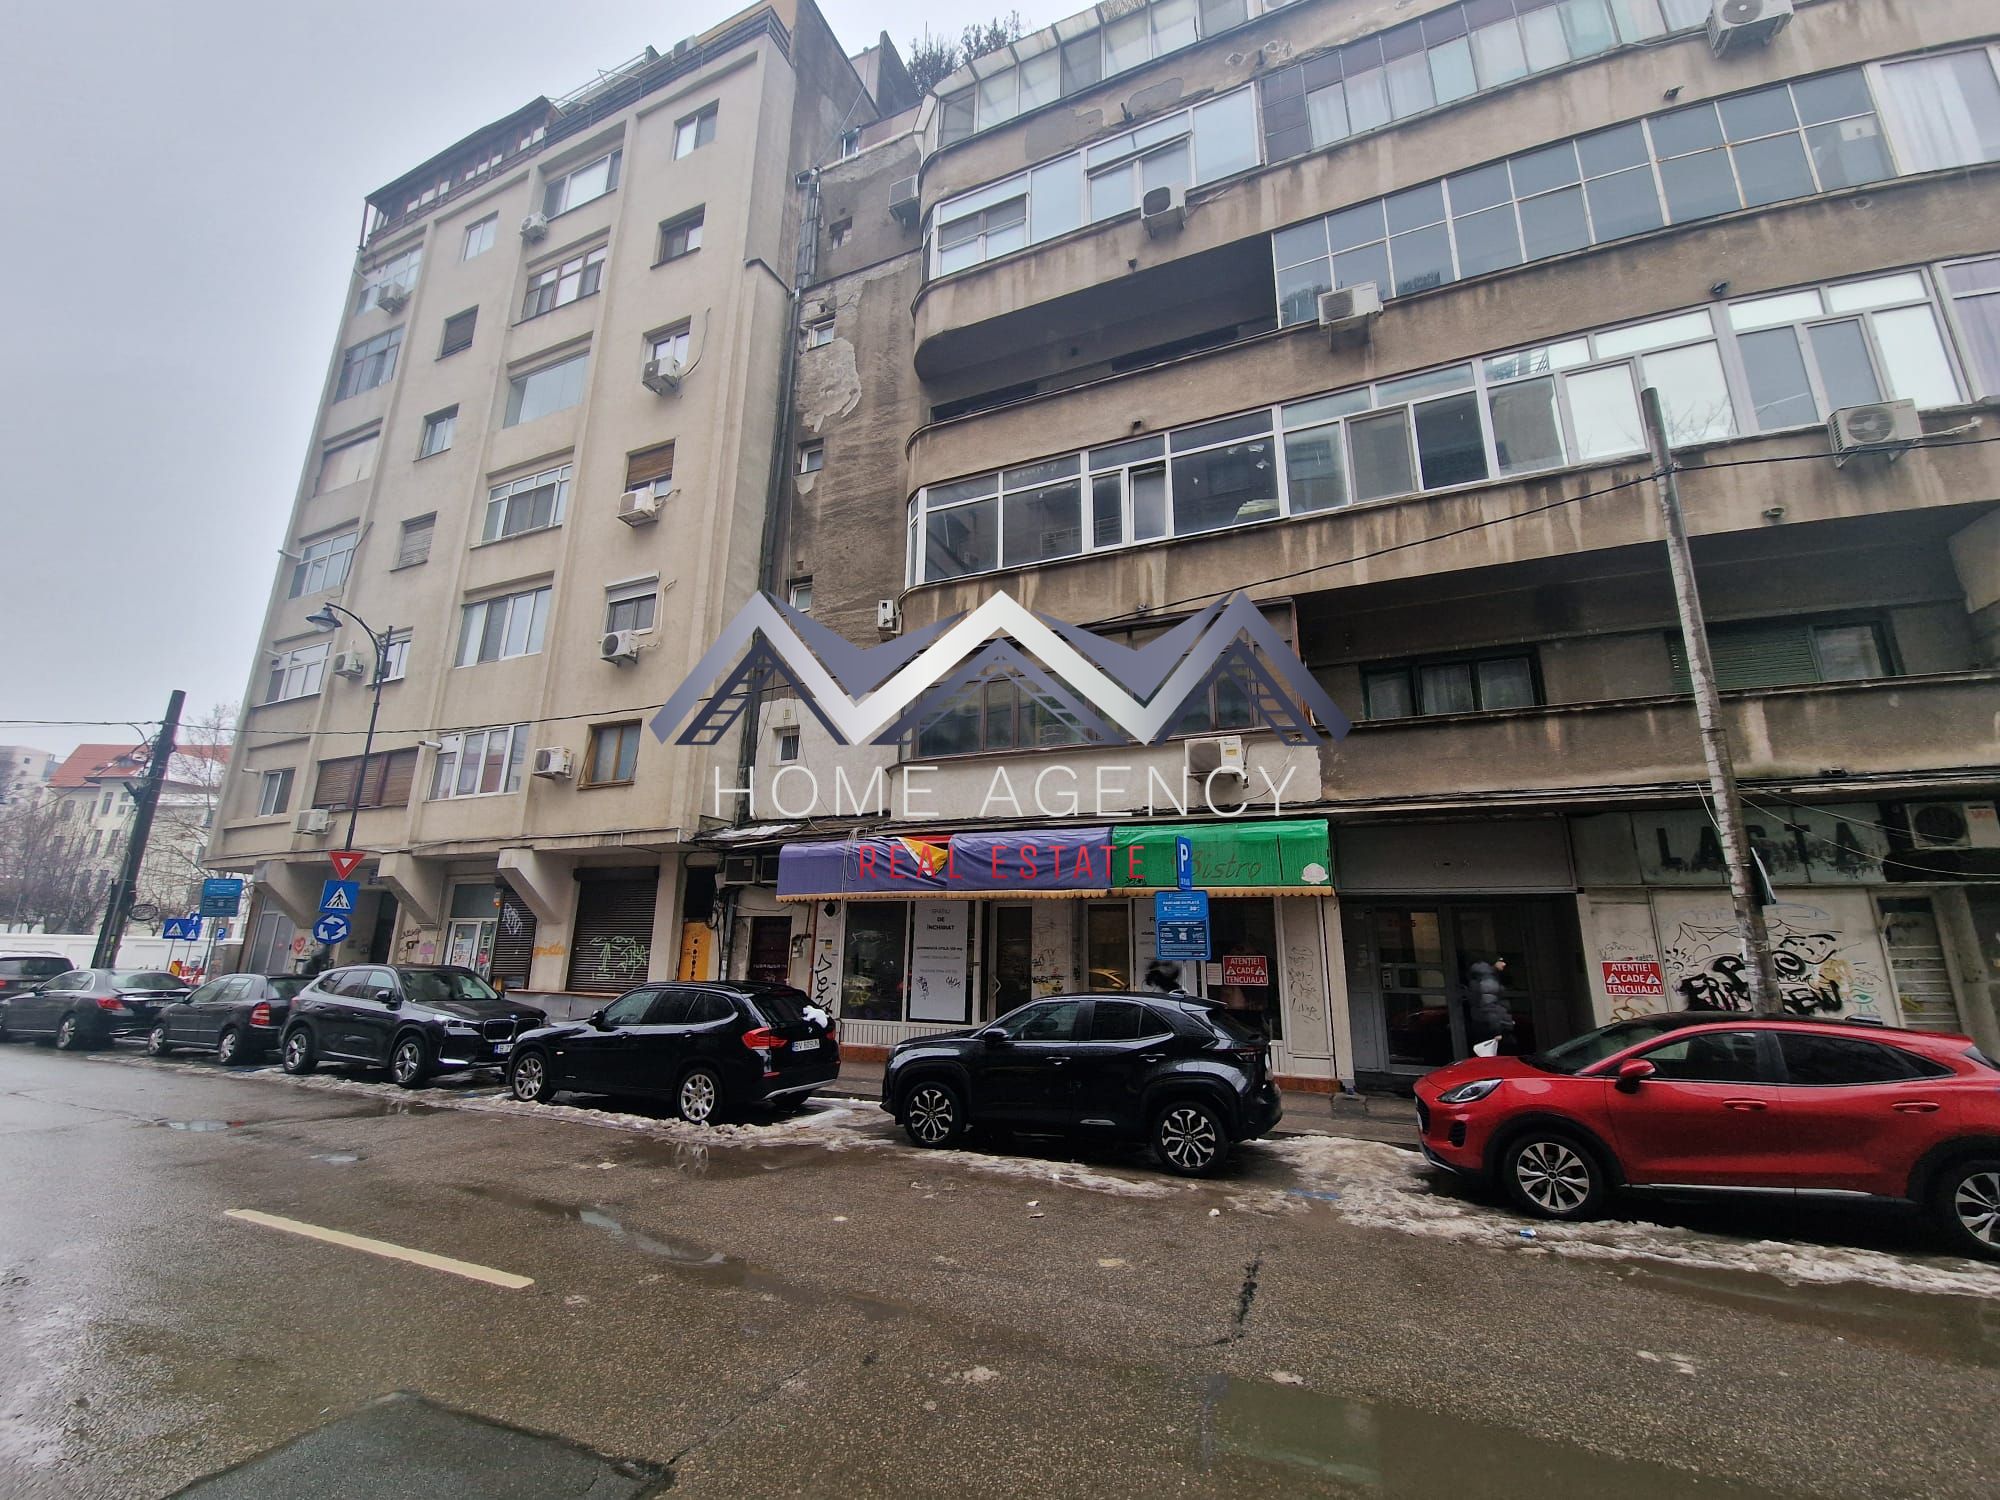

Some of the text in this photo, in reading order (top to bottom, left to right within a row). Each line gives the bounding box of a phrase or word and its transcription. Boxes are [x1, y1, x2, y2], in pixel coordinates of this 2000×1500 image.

[1180, 843, 1189, 872] P
[1236, 967, 1255, 975] CADE
[1611, 963, 1652, 973] ATENȚIE!
[1226, 976, 1267, 984] TENCUIALA!
[1620, 974, 1645, 983] CADE
[1606, 984, 1663, 994] TENCUIALA!
